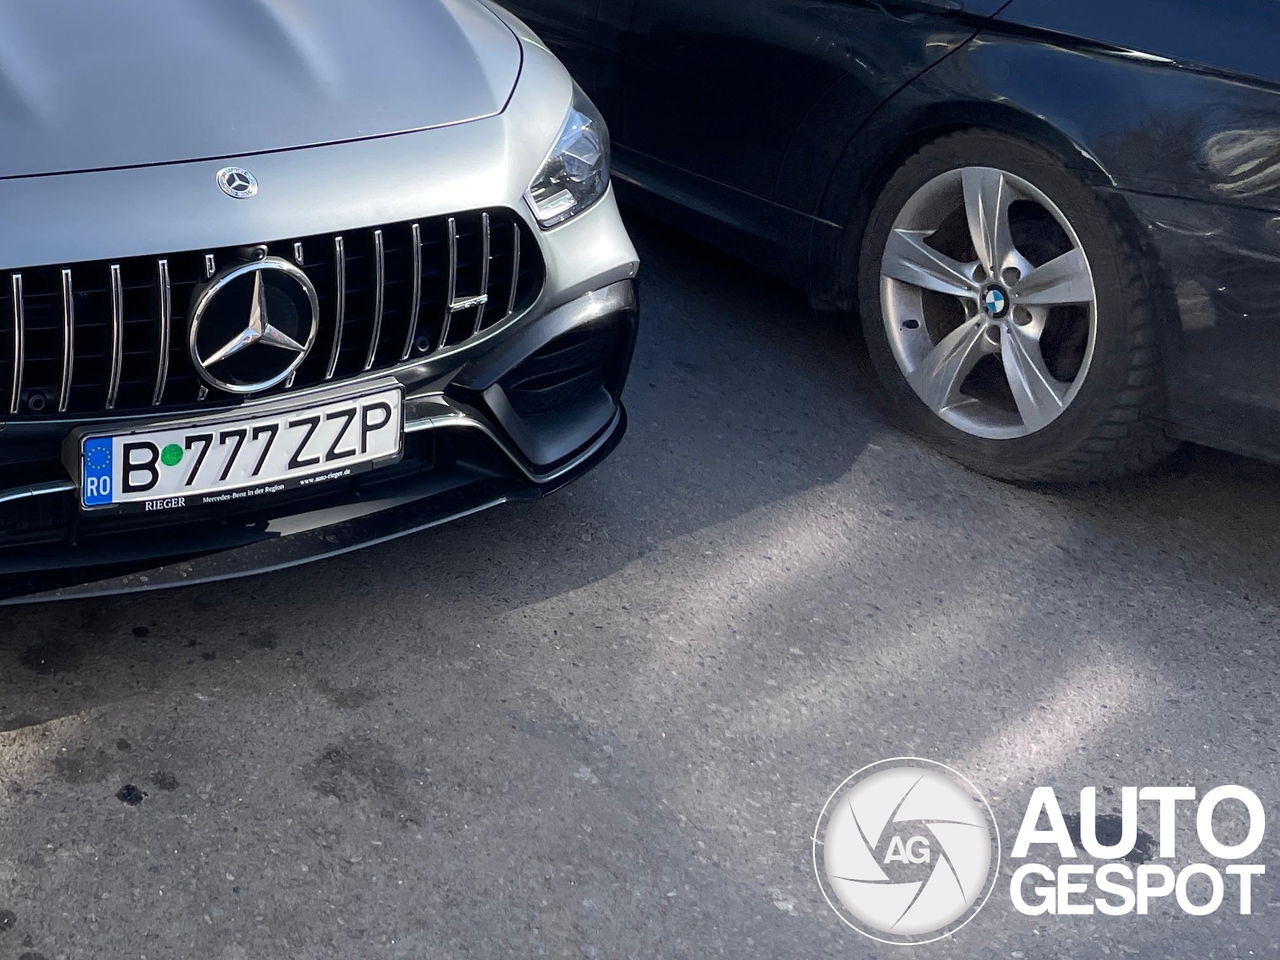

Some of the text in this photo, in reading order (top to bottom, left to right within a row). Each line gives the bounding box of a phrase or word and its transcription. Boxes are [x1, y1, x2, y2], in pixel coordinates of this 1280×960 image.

[122, 441, 160, 494] B
[87, 475, 111, 497] RO
[201, 488, 248, 504] Mercedes-Benz
[255, 487, 264, 495] der
[264, 483, 286, 494] Region
[145, 496, 187, 512] RIEGER
